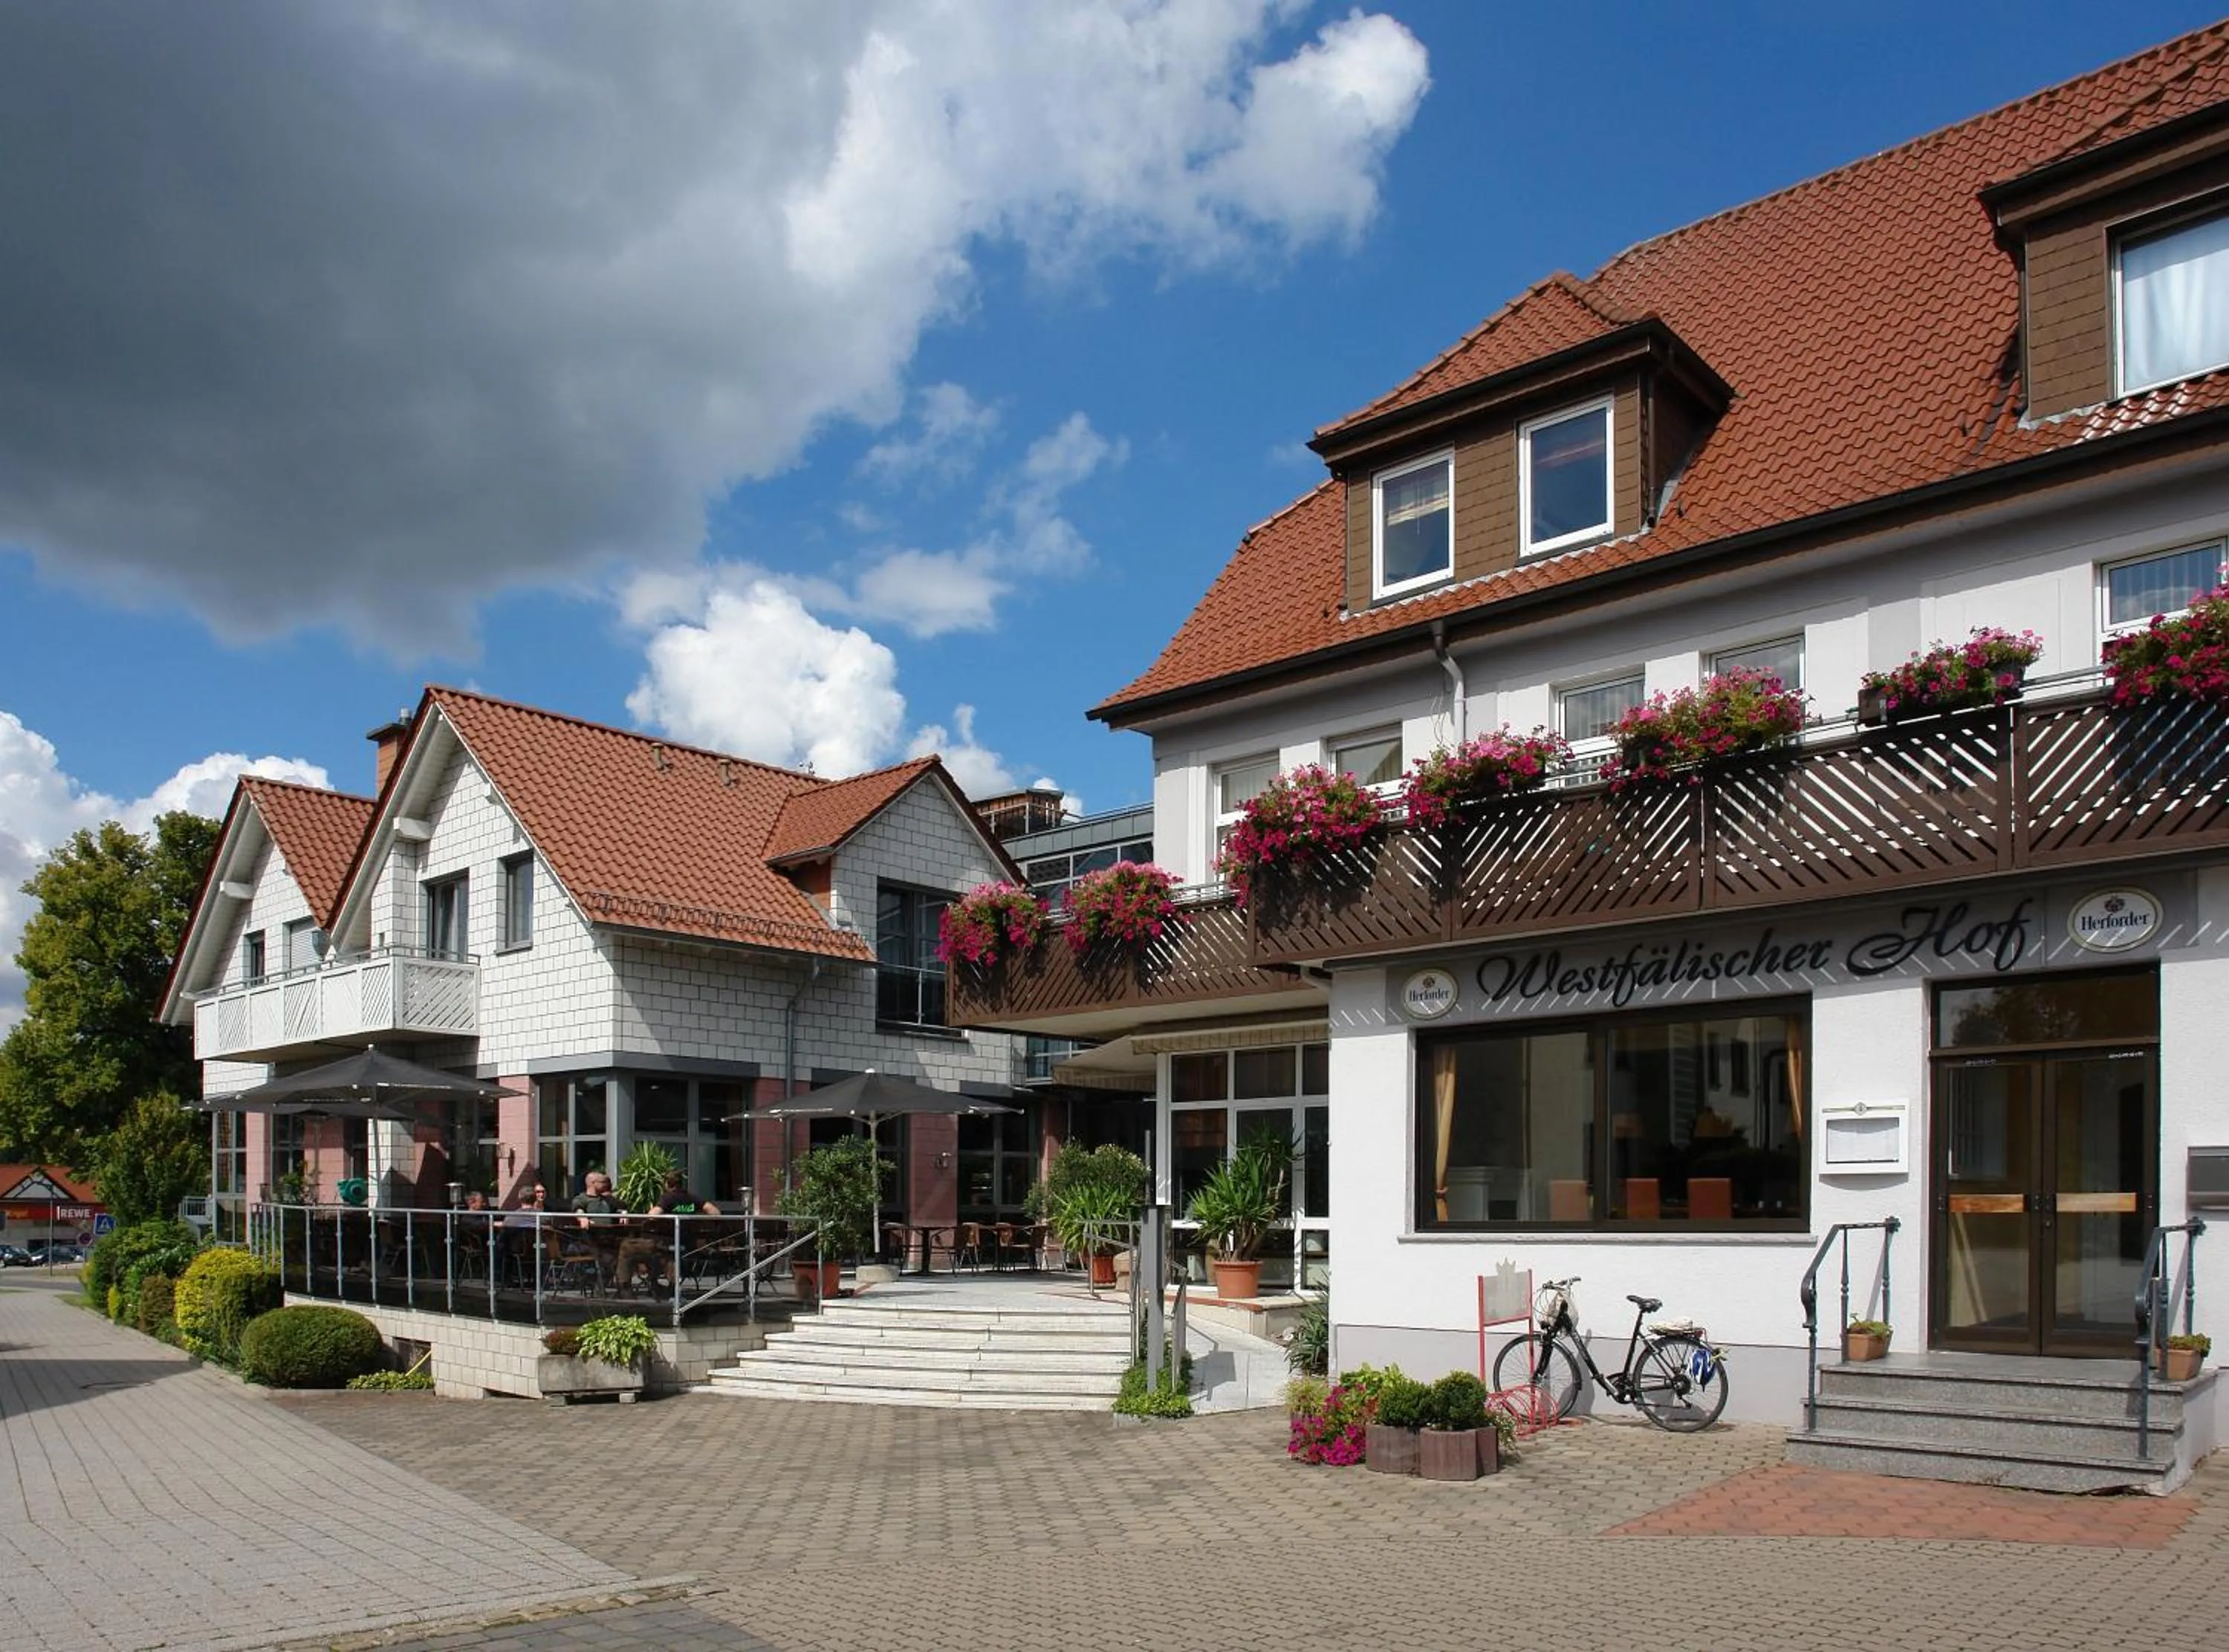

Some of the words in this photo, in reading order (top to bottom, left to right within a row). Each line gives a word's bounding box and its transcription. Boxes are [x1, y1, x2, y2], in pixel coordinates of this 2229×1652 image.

[2081, 911, 2150, 931] Herforder
[1477, 927, 1833, 1007] Westfälischer
[1846, 897, 2033, 976] Hof
[61, 1208, 91, 1218] REWE
